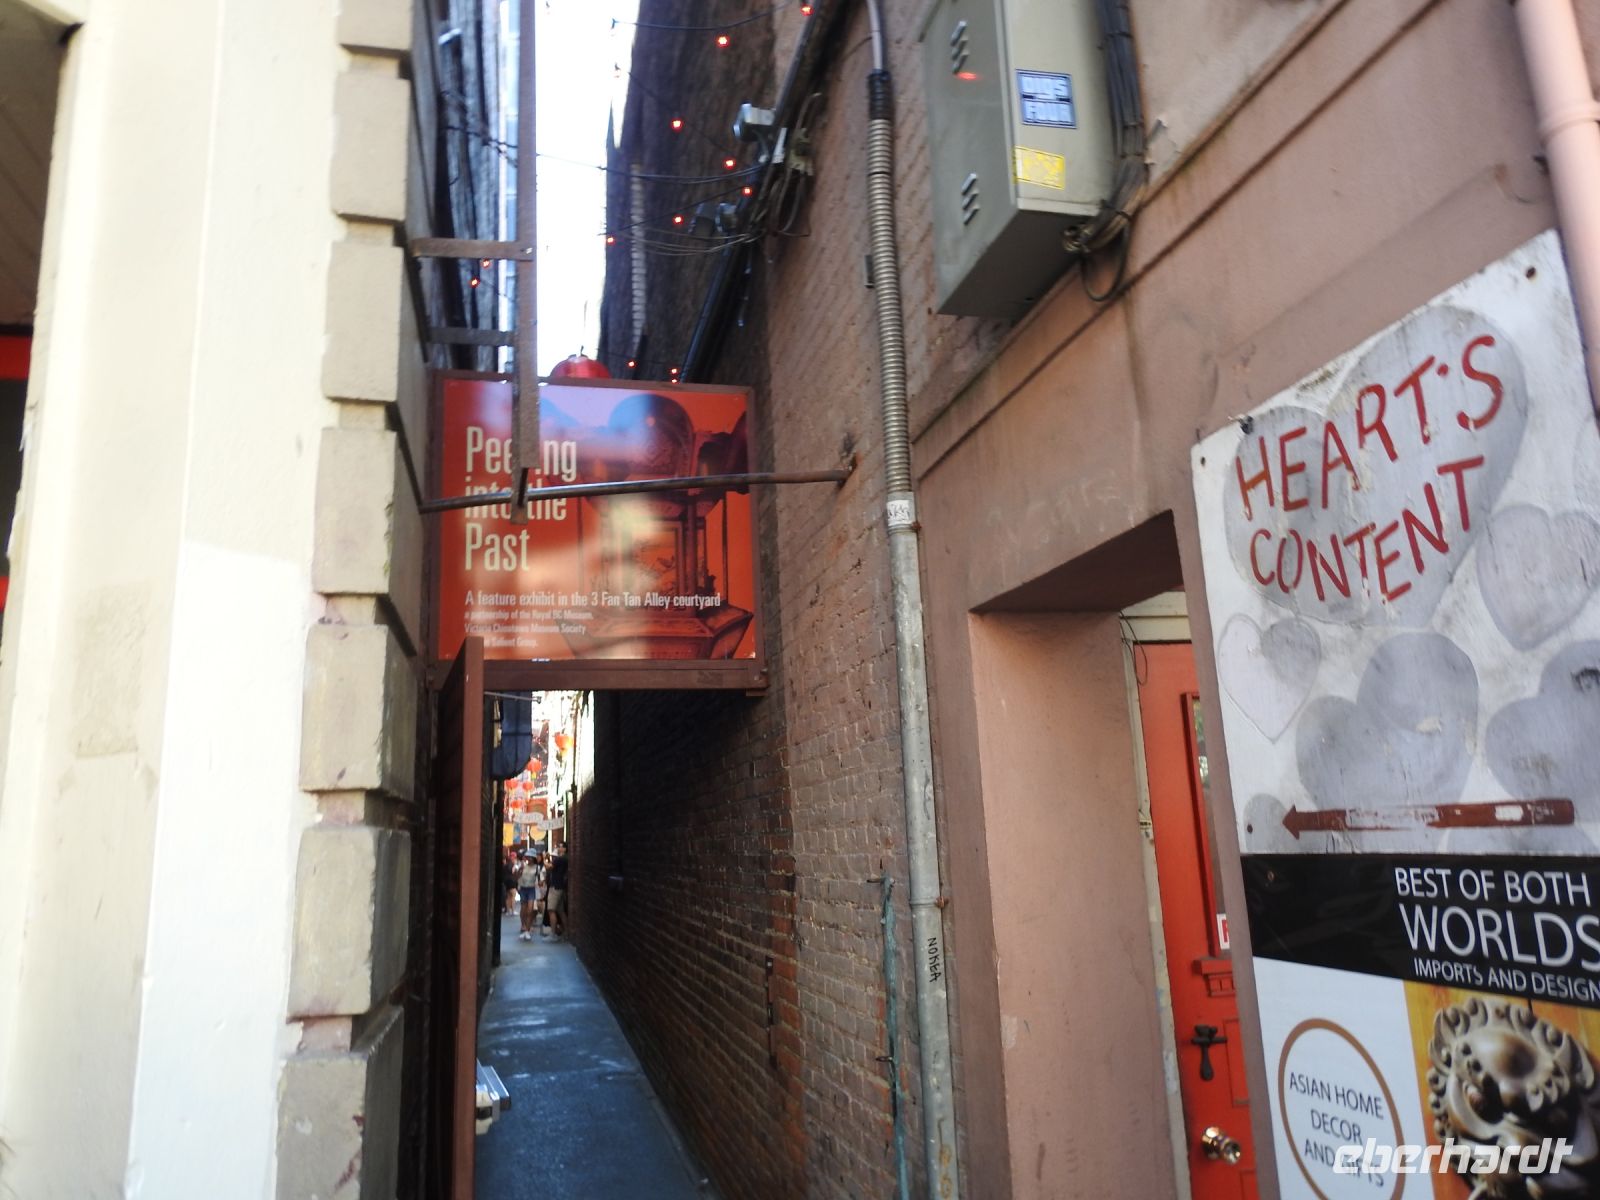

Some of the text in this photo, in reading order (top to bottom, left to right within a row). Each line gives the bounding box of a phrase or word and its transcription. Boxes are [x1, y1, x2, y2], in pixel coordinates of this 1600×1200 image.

[465, 523, 530, 571] Past
[1249, 455, 1485, 604] CONTENT
[465, 590, 721, 610] A feature exhibit in the 3 Fan Tan Alley courtyard
[561, 624, 586, 635] Society
[1395, 867, 1591, 907] BEST OF BOTH
[1399, 903, 1600, 973] WORLDS
[1414, 957, 1484, 986] IMPORTS
[1488, 966, 1526, 992] AND
[1290, 1071, 1384, 1120] ASIAN HOME
[1310, 1108, 1363, 1146] DECOR
[1304, 1138, 1336, 1167] AND
